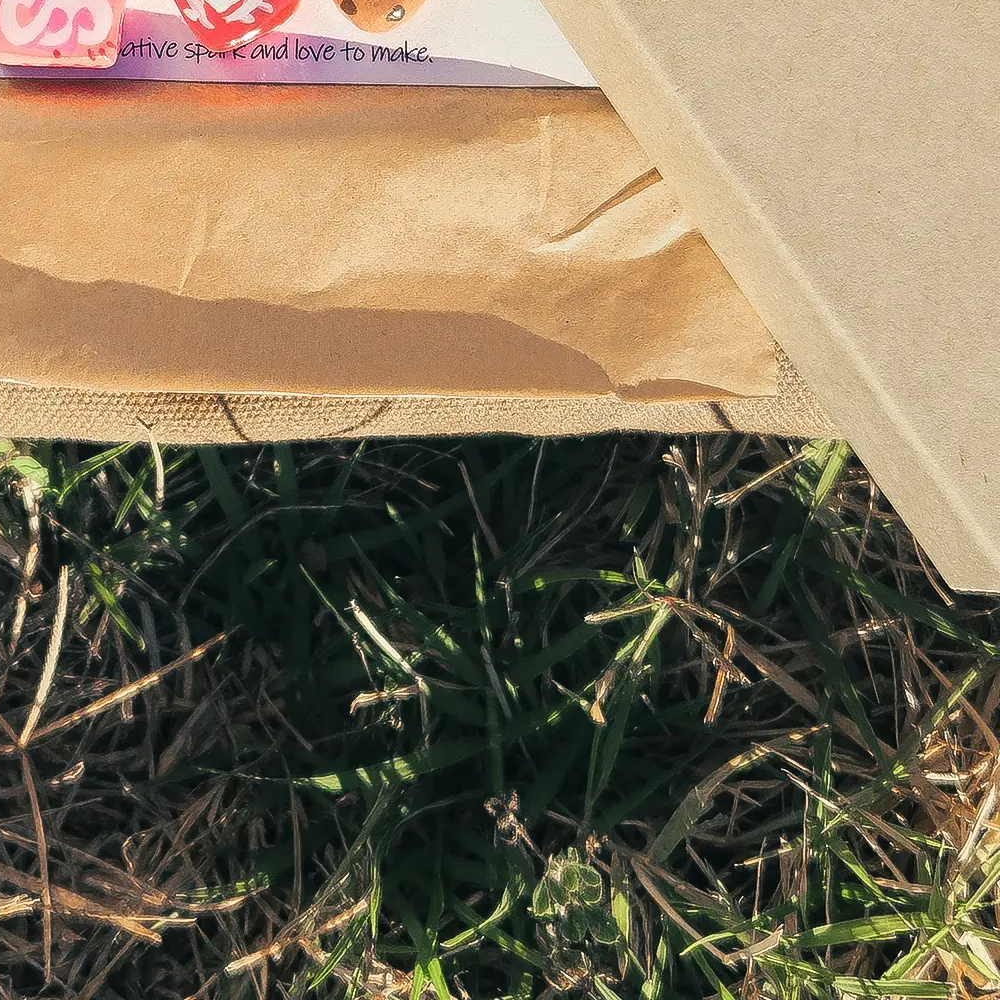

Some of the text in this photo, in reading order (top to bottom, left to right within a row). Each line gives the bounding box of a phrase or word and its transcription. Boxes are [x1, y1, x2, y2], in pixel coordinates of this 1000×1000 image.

[119, 36, 179, 59] ative
[250, 37, 289, 60] and
[294, 38, 334, 62] love
[340, 41, 366, 62] to
[370, 41, 434, 65] make.
